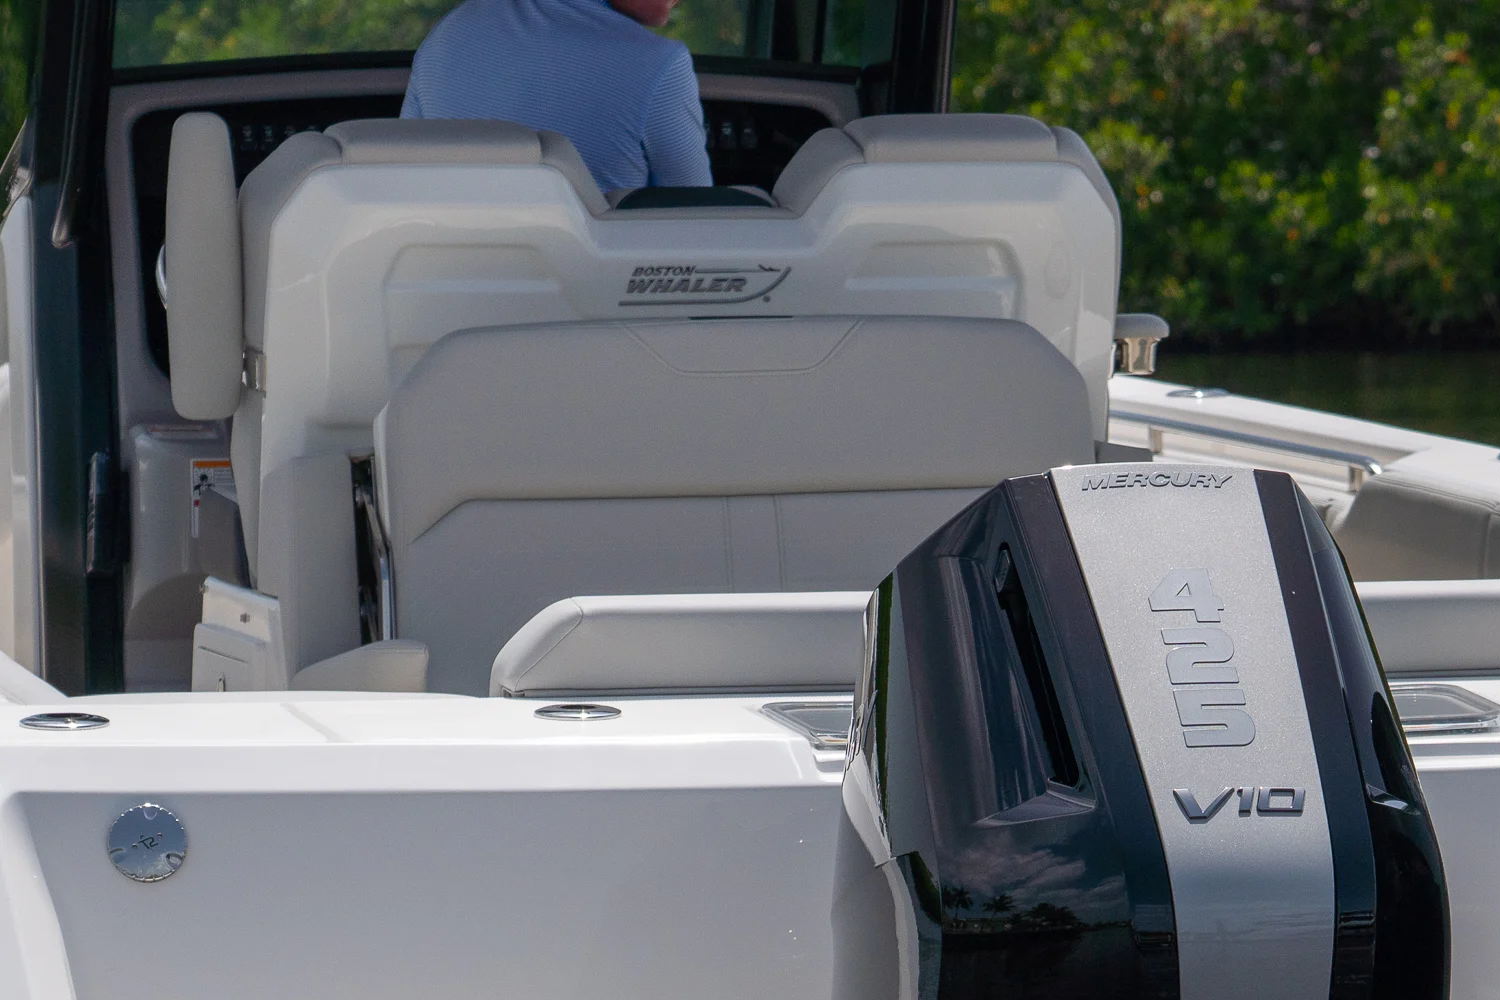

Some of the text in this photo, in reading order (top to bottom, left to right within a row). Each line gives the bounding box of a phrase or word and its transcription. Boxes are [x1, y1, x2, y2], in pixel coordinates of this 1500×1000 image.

[631, 265, 697, 277] BOSTON
[626, 276, 747, 293] WHALER
[1081, 471, 1234, 491] MERCURY
[1148, 567, 1257, 749] 425
[1172, 786, 1306, 822] V10
